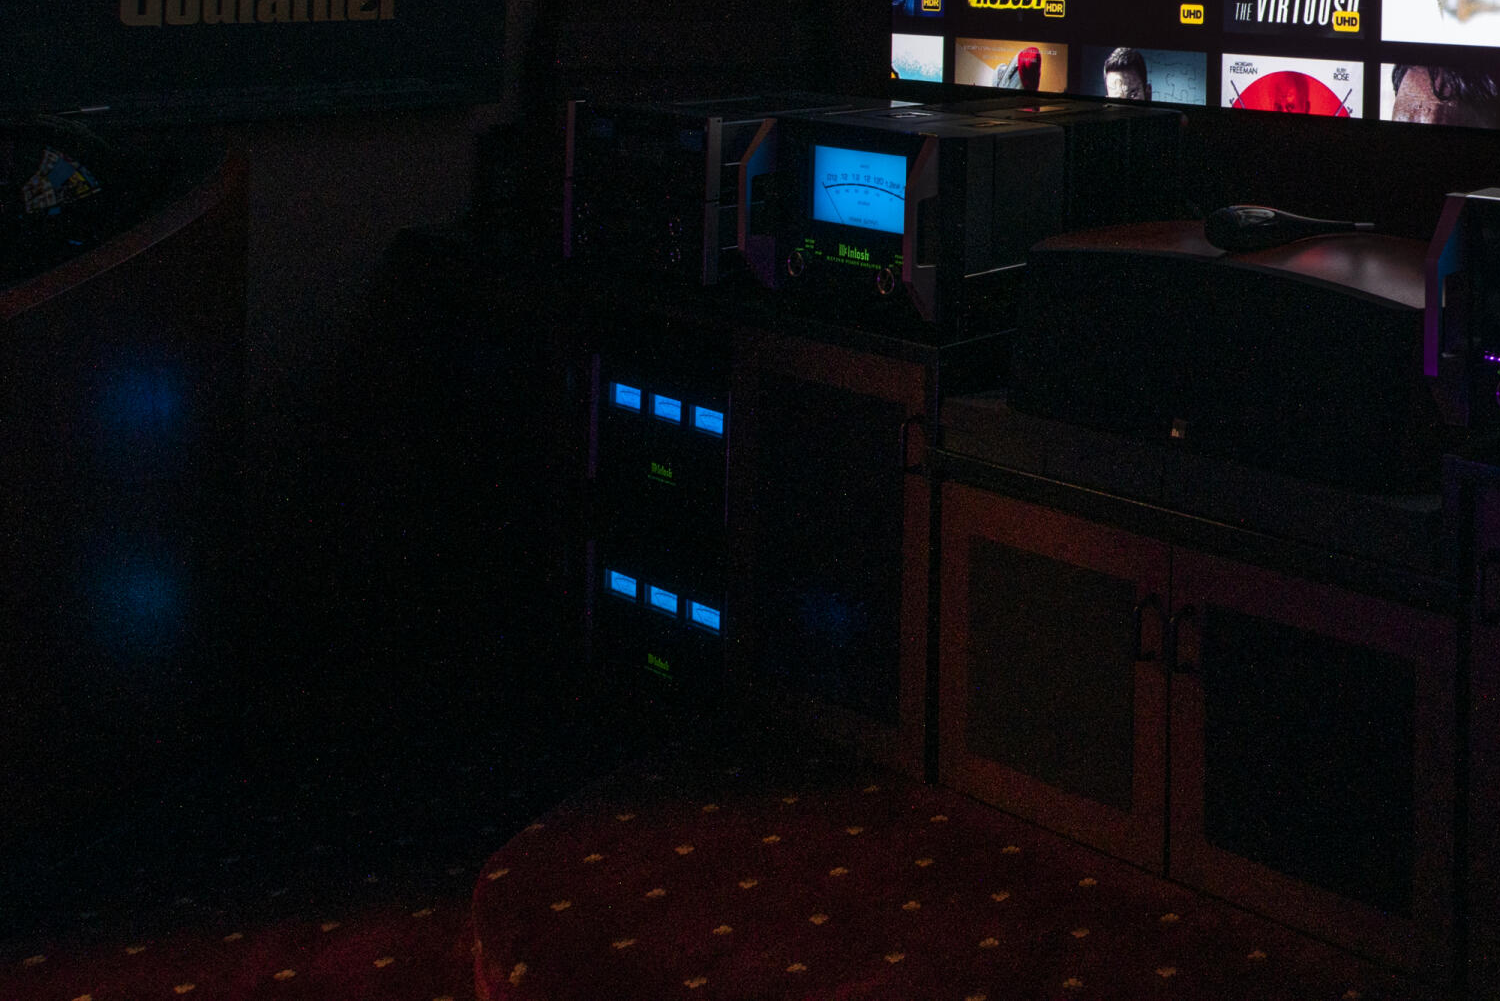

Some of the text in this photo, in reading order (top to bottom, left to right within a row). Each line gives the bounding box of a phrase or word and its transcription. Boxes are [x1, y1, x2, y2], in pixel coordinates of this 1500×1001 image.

[1045, 2, 1064, 13] HDR
[1234, 1, 1253, 22] THE
[1182, 8, 1203, 20] UHD
[1335, 15, 1358, 28] UHD
